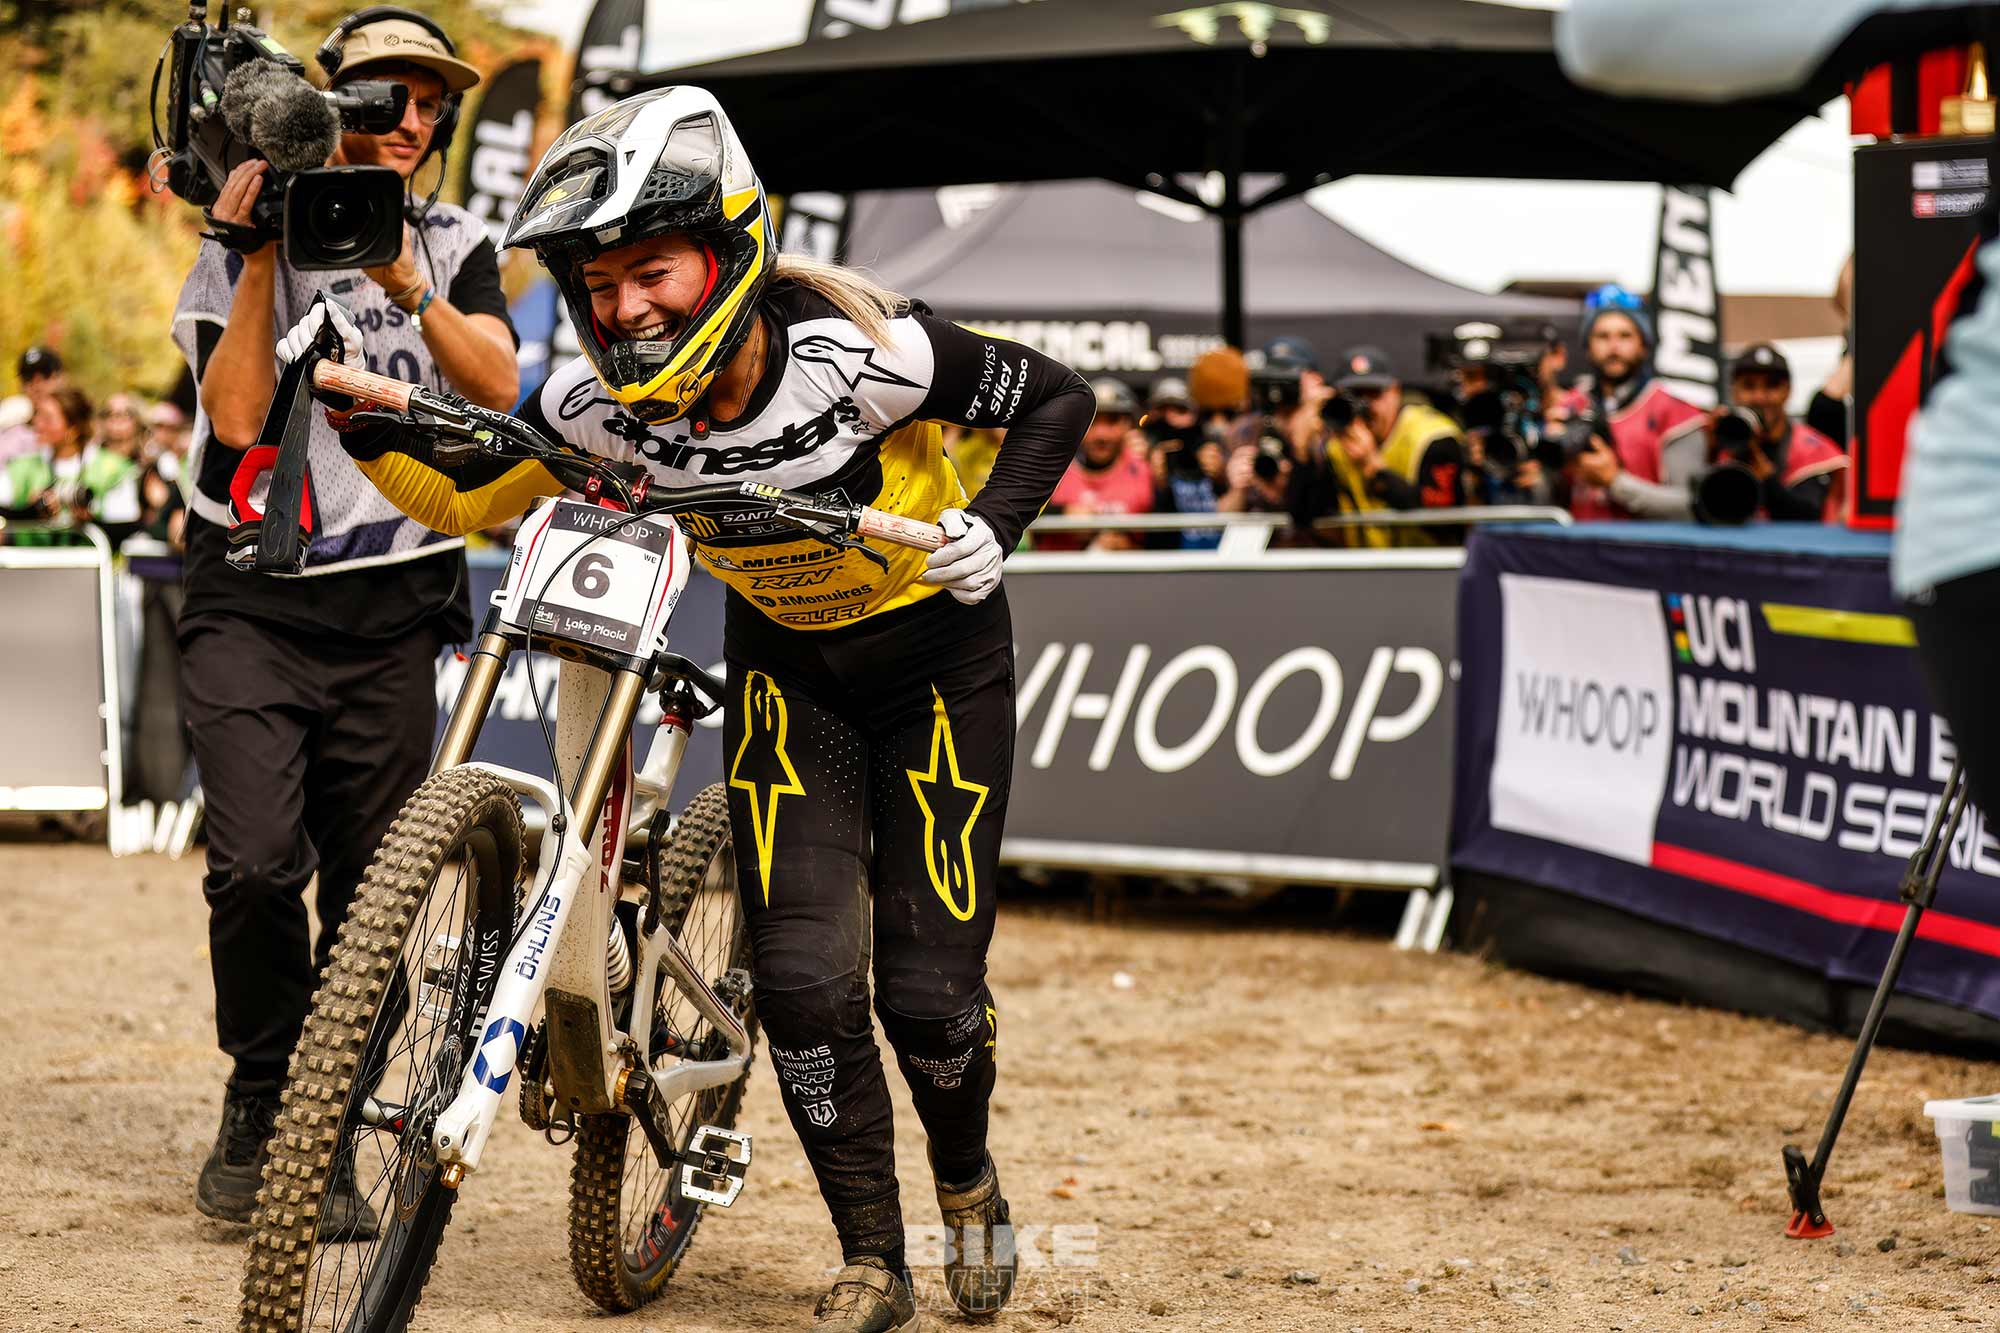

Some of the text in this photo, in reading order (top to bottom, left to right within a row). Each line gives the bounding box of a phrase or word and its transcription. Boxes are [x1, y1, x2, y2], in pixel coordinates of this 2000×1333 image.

[1654, 183, 1720, 412] MEN
[965, 343, 997, 421] DT SWISS
[990, 360, 1013, 416] slicy
[1002, 358, 1029, 423] wahoo
[573, 511, 649, 541] WHOOP
[572, 542, 615, 600] 6
[564, 617, 628, 642] Lake Placid
[1681, 594, 1757, 673] UCI
[1517, 671, 1660, 757] WHOOP
[1678, 673, 1917, 777] MOUNTAIN
[1672, 744, 1838, 842] WORLD
[476, 929, 500, 993] SWISS
[515, 894, 561, 981] ÖHLINS
